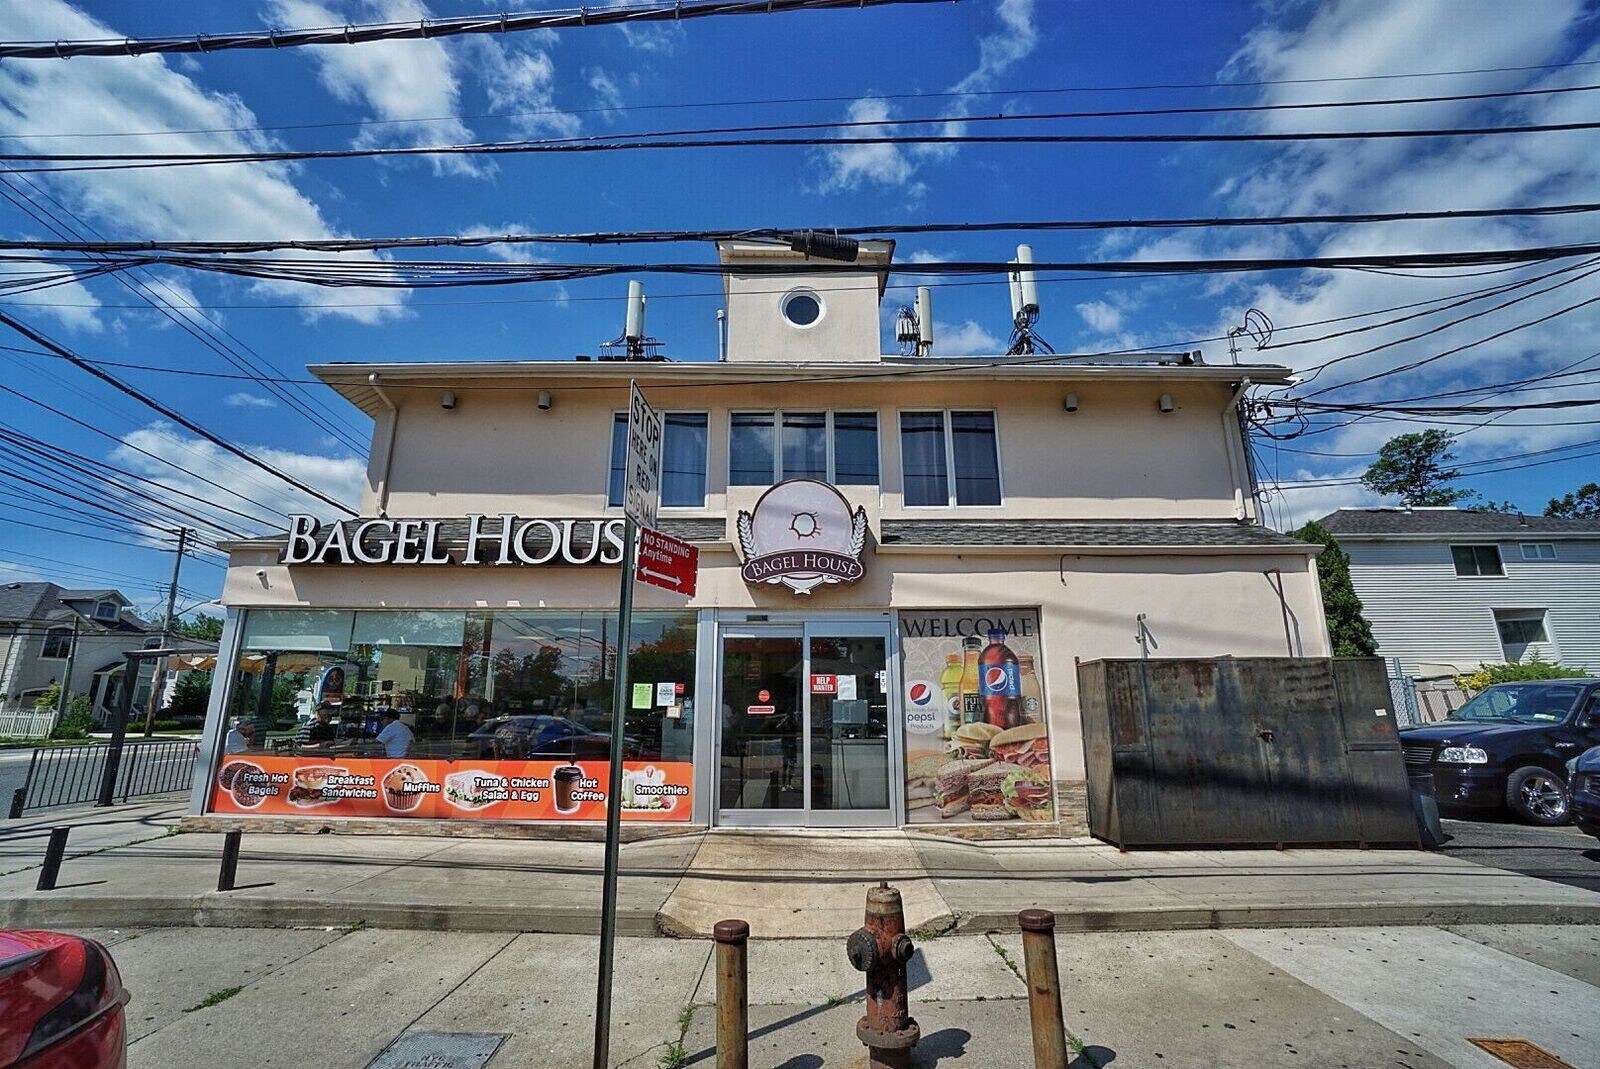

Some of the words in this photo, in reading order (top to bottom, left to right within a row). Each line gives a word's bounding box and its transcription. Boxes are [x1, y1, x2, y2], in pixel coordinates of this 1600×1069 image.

[633, 395, 659, 449] STOP
[632, 428, 647, 465] HERE
[649, 453, 657, 478] ON
[636, 463, 651, 493] RED
[281, 513, 449, 564] BAGEL
[462, 513, 626, 564] HOUS
[643, 533, 655, 546] NO
[655, 537, 690, 559] STANDING
[642, 545, 673, 565] Anytime
[751, 555, 800, 577] BAGEL
[803, 553, 857, 576] HOUSE
[902, 617, 1034, 638] WELCOME
[816, 676, 831, 685] HELP
[1006, 668, 1016, 690] pepsi
[813, 684, 834, 692] WANTED
[907, 712, 936, 724] pepsi
[243, 773, 269, 783] Fresh
[271, 773, 288, 784] Hot
[328, 775, 375, 786] Breakfast
[474, 777, 499, 788] Tuna
[501, 778, 508, 788] &
[510, 778, 549, 788] Chicken
[579, 778, 598, 788] Hot
[248, 785, 279, 796] Bagels
[321, 787, 377, 798] Sandwiches
[403, 782, 441, 793] Muffins
[635, 785, 688, 796] Smoothies
[482, 790, 509, 800] Salad
[511, 791, 519, 800] &
[520, 791, 539, 802] Egg
[570, 791, 605, 801] Coffee
